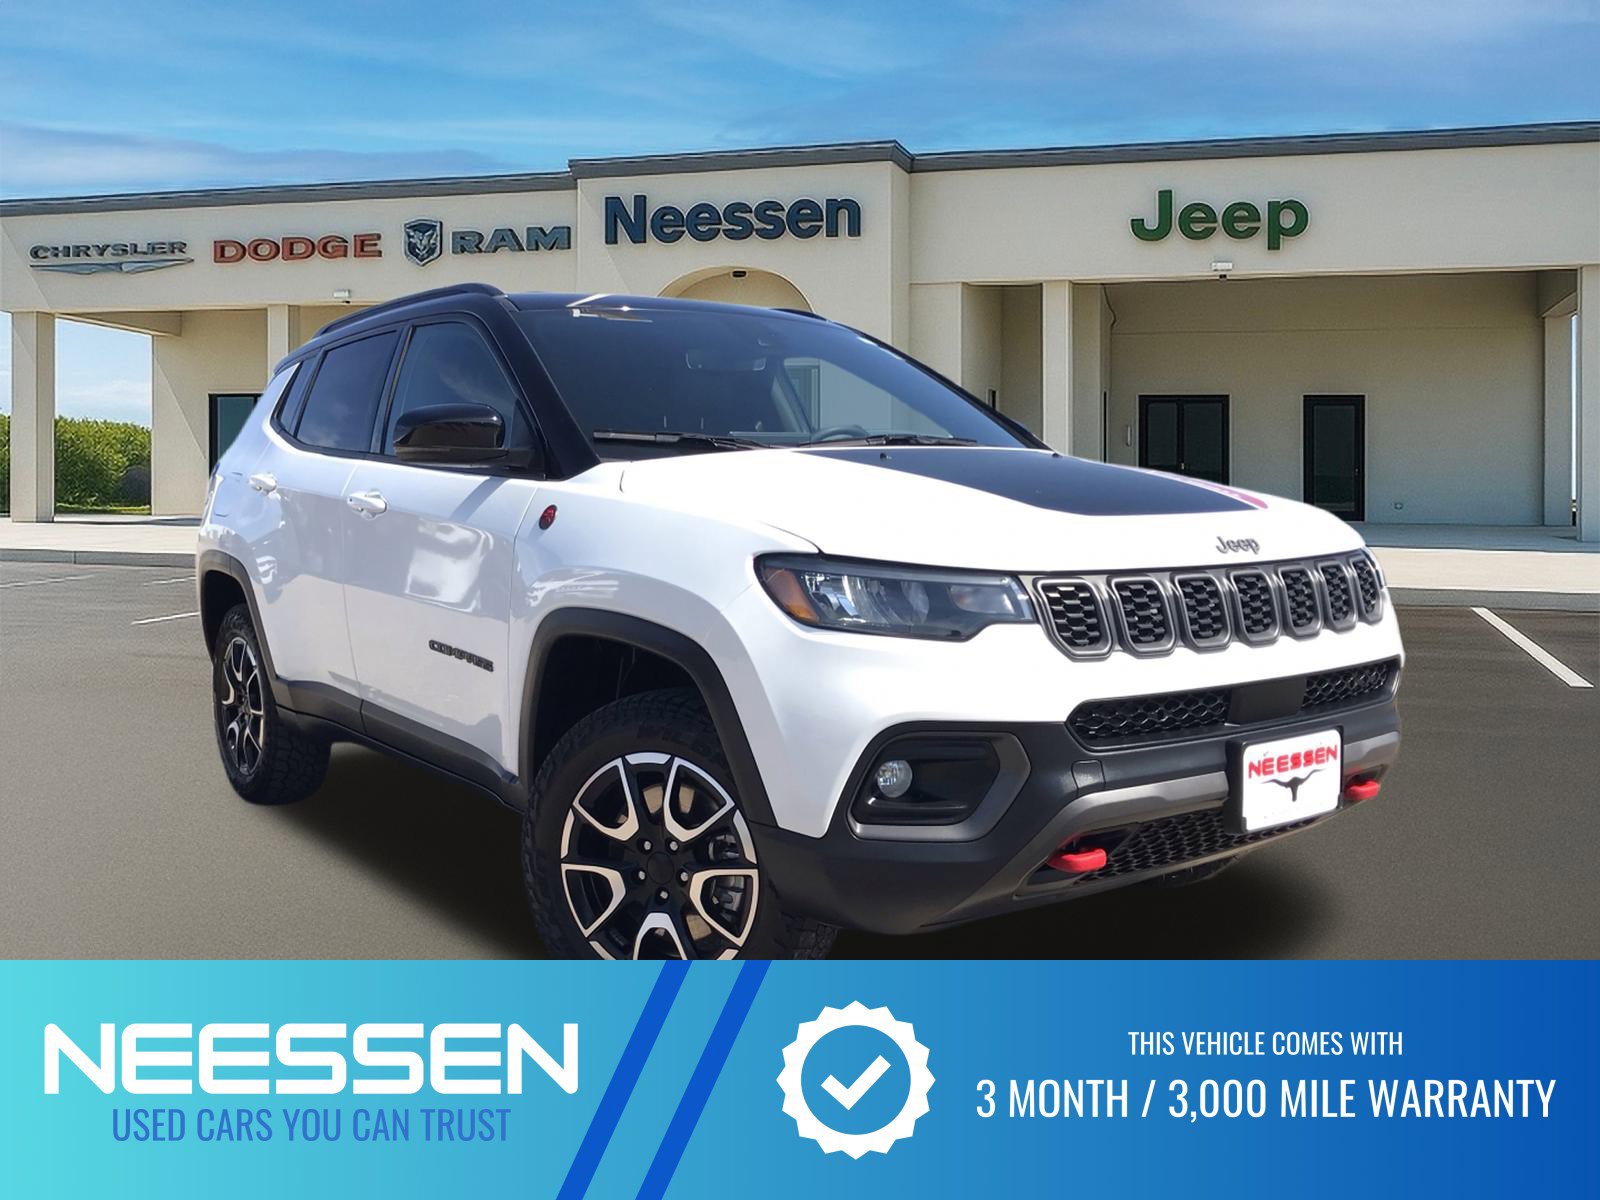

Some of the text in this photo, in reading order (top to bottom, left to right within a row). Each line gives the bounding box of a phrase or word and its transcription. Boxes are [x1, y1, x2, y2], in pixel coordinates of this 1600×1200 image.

[604, 194, 861, 245] Neessen
[1130, 190, 1309, 250] Jeep
[29, 241, 188, 259] CHRYSLER
[213, 233, 382, 264] DODGE
[451, 225, 571, 254] RAM
[1216, 536, 1260, 555] Jeep
[1248, 745, 1338, 778] NEESSEN
